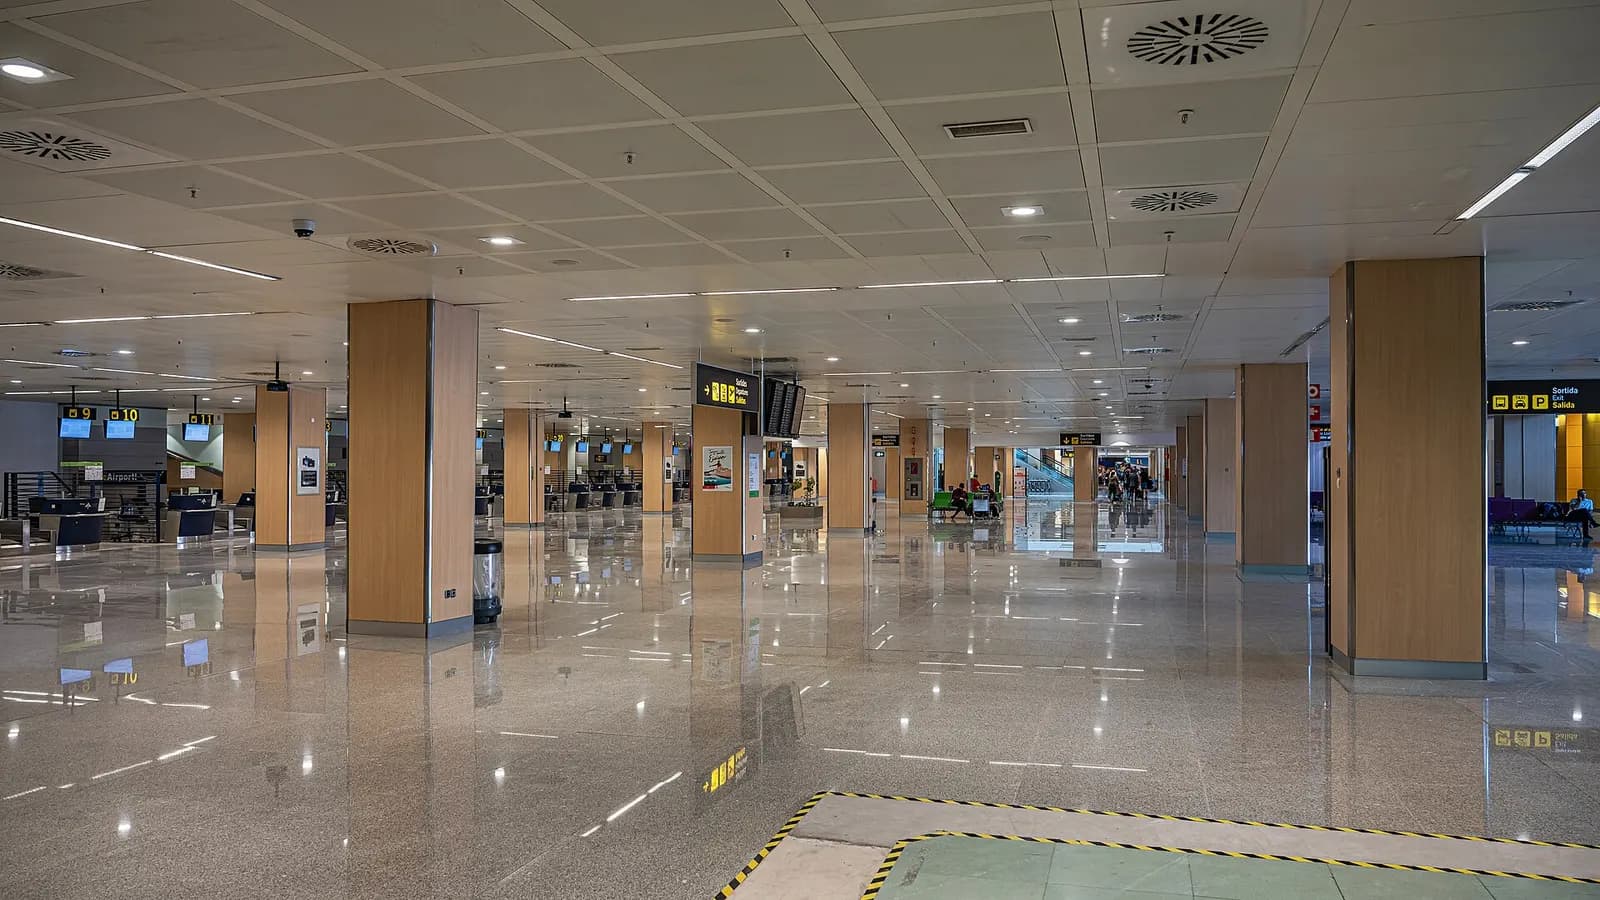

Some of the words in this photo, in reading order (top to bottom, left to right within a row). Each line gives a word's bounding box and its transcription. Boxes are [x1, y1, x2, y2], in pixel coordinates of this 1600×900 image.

[1536, 397, 1545, 407] P
[82, 408, 91, 420] 9
[123, 409, 138, 421] 10
[200, 414, 212, 425] 11
